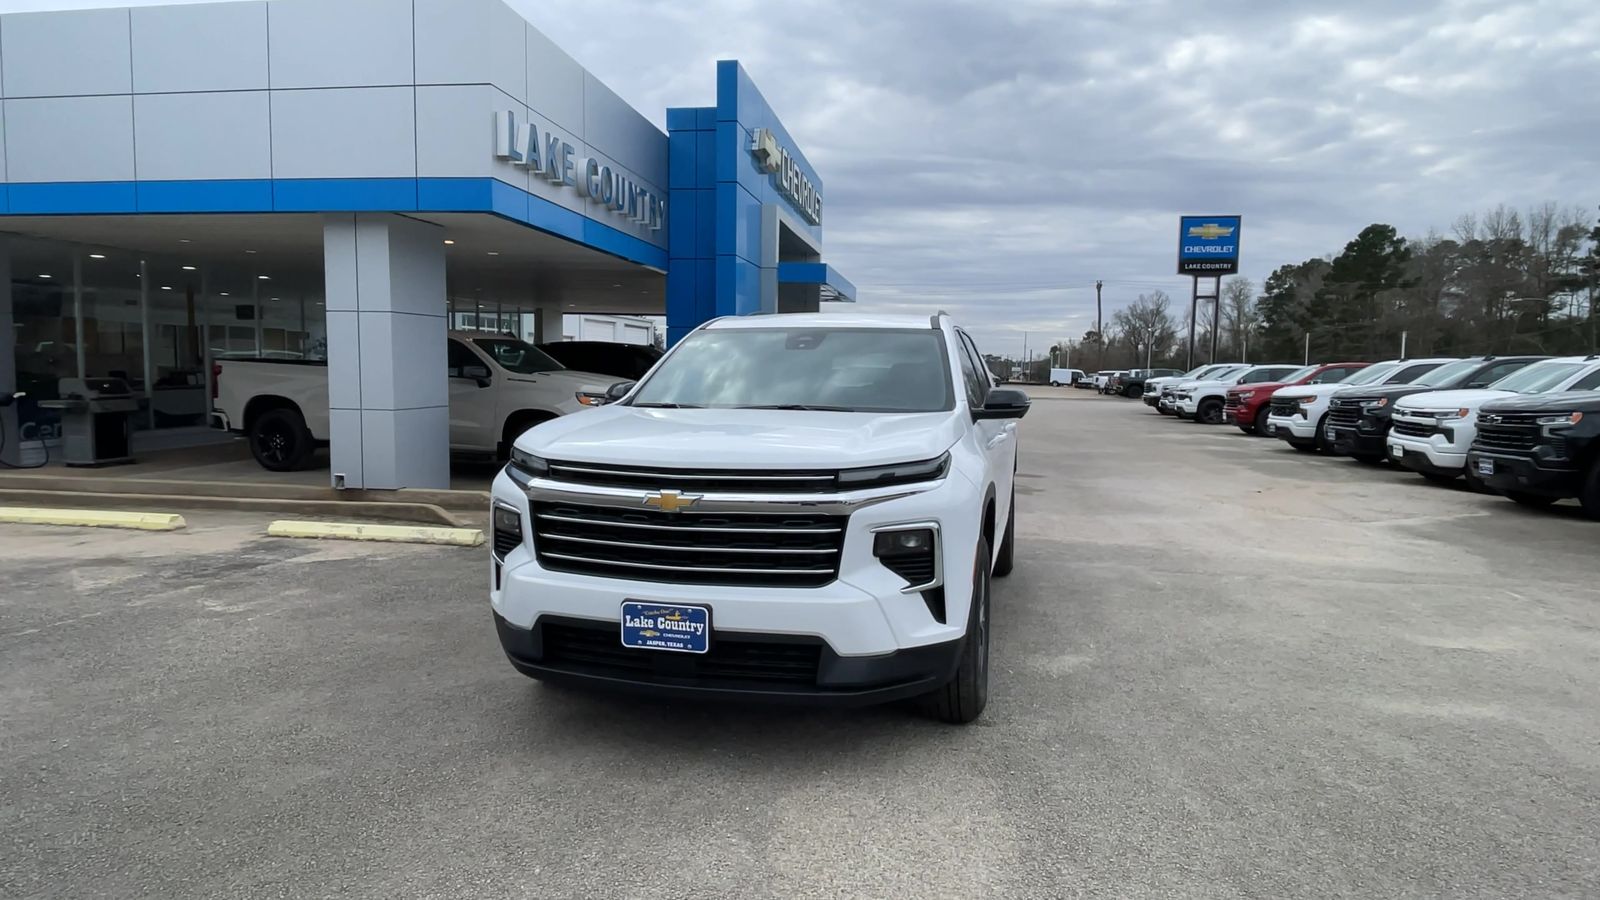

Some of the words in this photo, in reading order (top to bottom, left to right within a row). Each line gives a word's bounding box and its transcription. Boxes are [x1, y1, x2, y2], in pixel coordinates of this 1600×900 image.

[496, 110, 576, 187] LAKE
[576, 157, 667, 230] COUNTRY
[781, 146, 822, 224] CHEVROLET
[1184, 245, 1234, 253] CHEVROLET
[625, 615, 654, 628] Lake
[657, 617, 704, 635] Country
